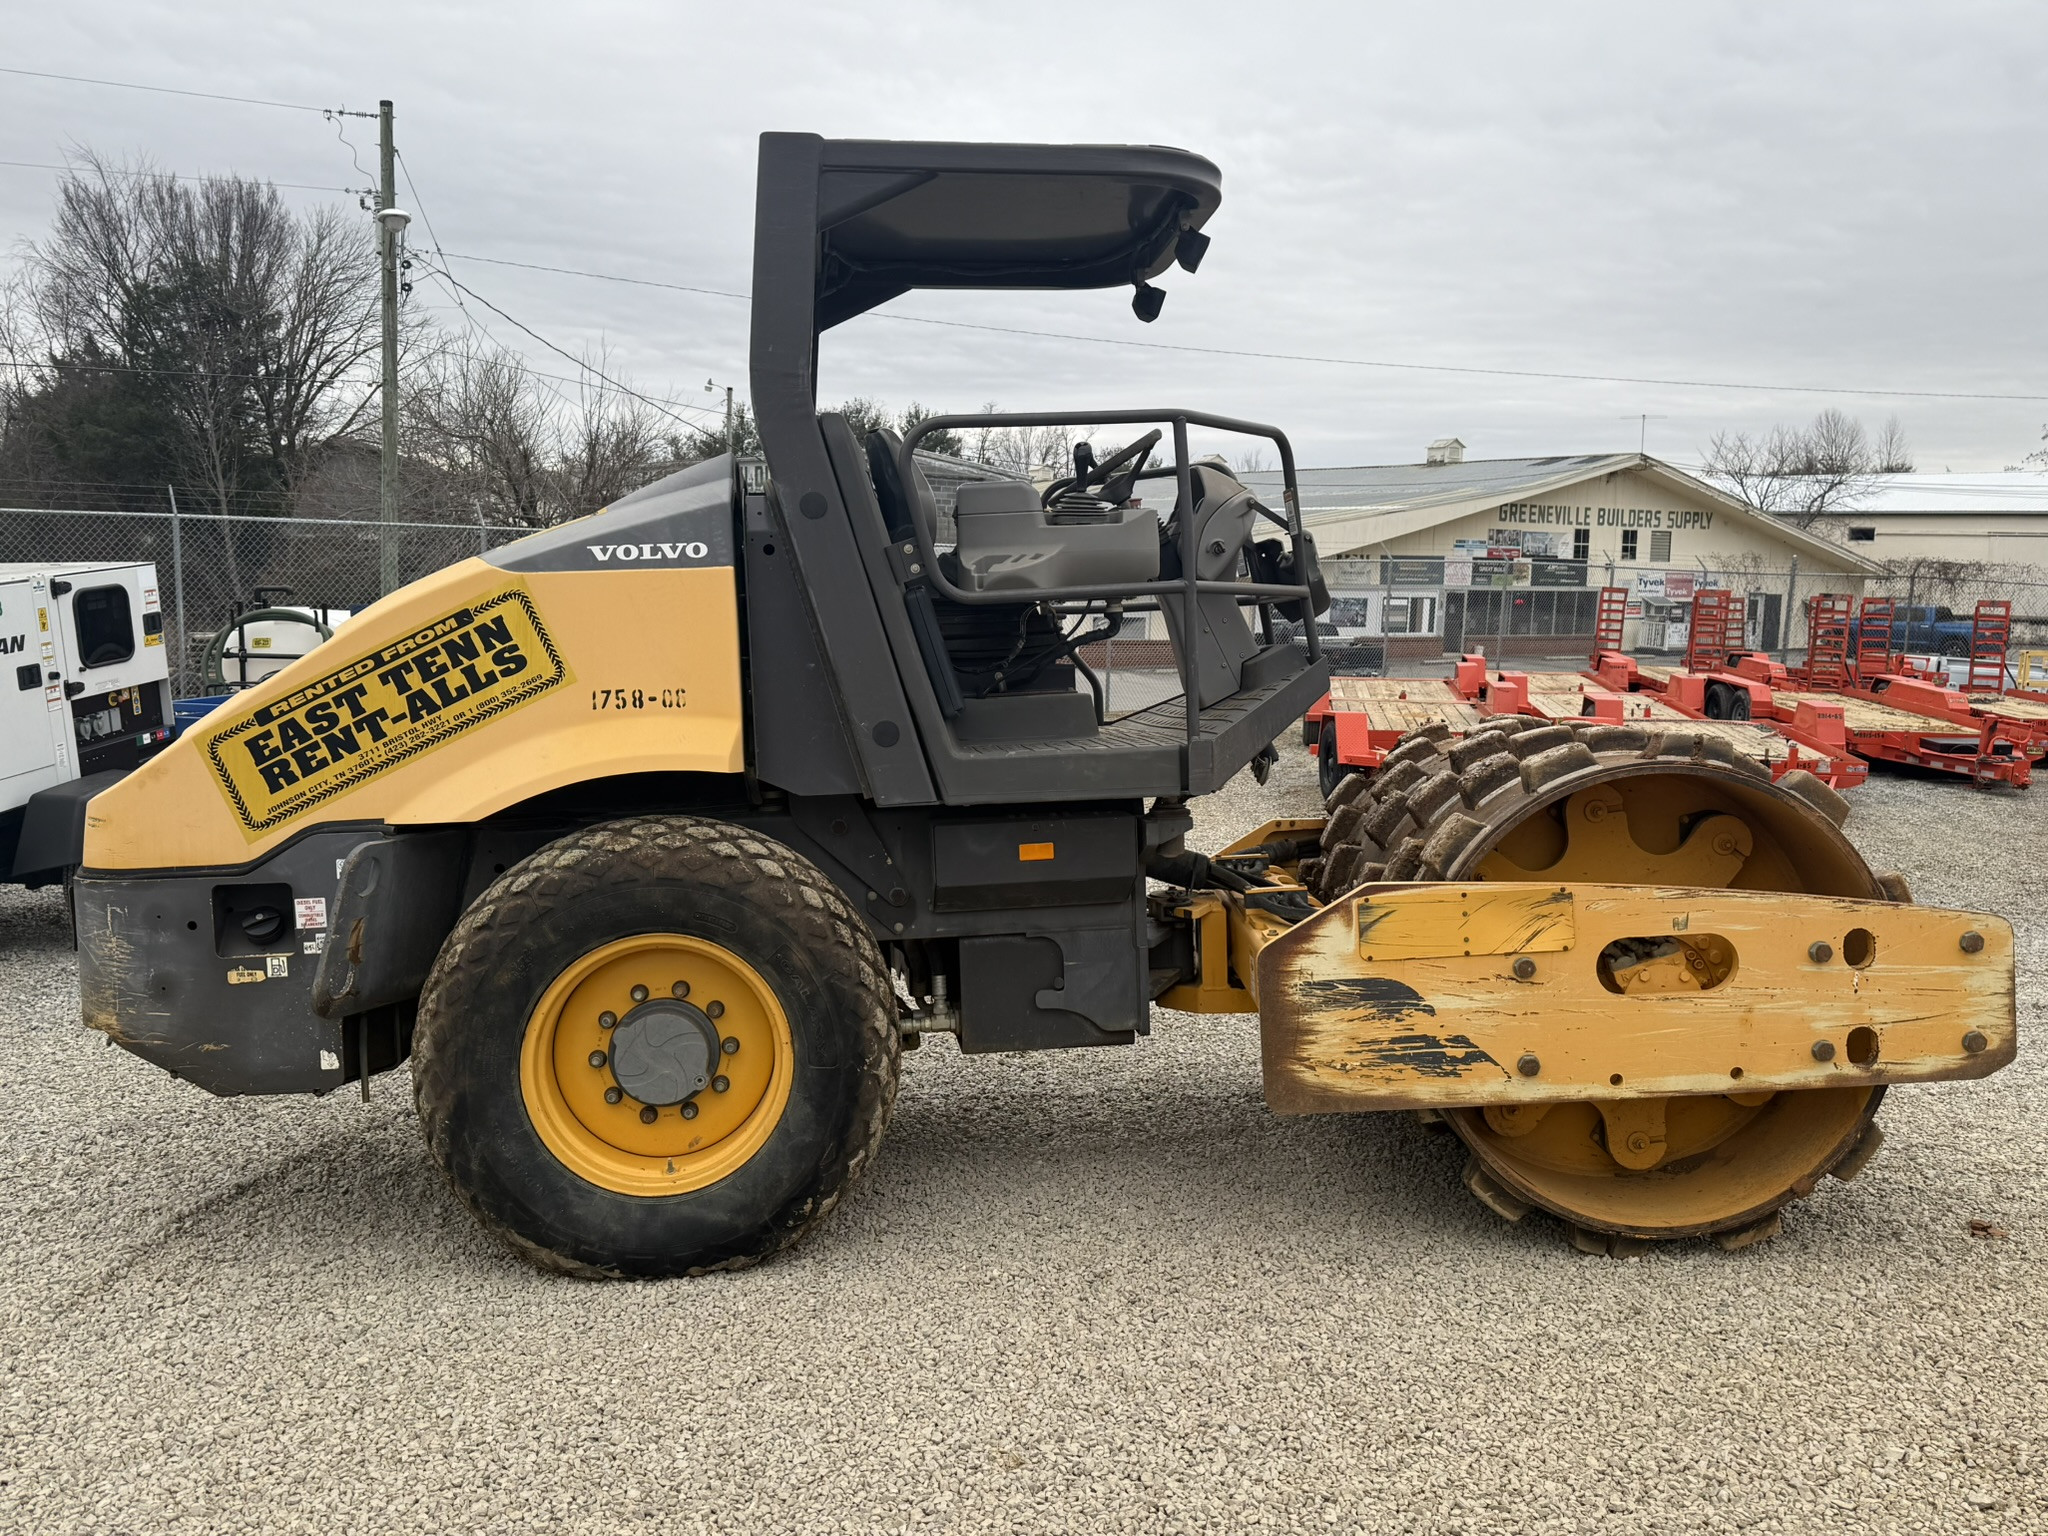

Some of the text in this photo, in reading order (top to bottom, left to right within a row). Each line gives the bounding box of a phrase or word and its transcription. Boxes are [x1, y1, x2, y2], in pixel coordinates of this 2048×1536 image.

[1498, 503, 1713, 530] GREENEVILLE BUILDERS SUPPLY
[586, 541, 709, 561] VOLVO
[1638, 577, 1665, 588] Tyvek
[1665, 588, 1688, 597] Tyvek
[244, 615, 514, 767] EAST TENN
[269, 620, 460, 718] RENTED FROM
[257, 643, 528, 795] RENT-ALLS
[357, 714, 443, 761] 3711 BRISTOL HWY
[266, 790, 307, 815] JOHNSON
[308, 779, 332, 794] CITY,
[333, 771, 346, 781] TN
[347, 757, 375, 774] 37601
[384, 740, 408, 757] (423)
[409, 719, 451, 744] 282-3221
[452, 711, 467, 722] OR
[476, 695, 500, 712] (800)
[500, 674, 543, 698] 352-2669
